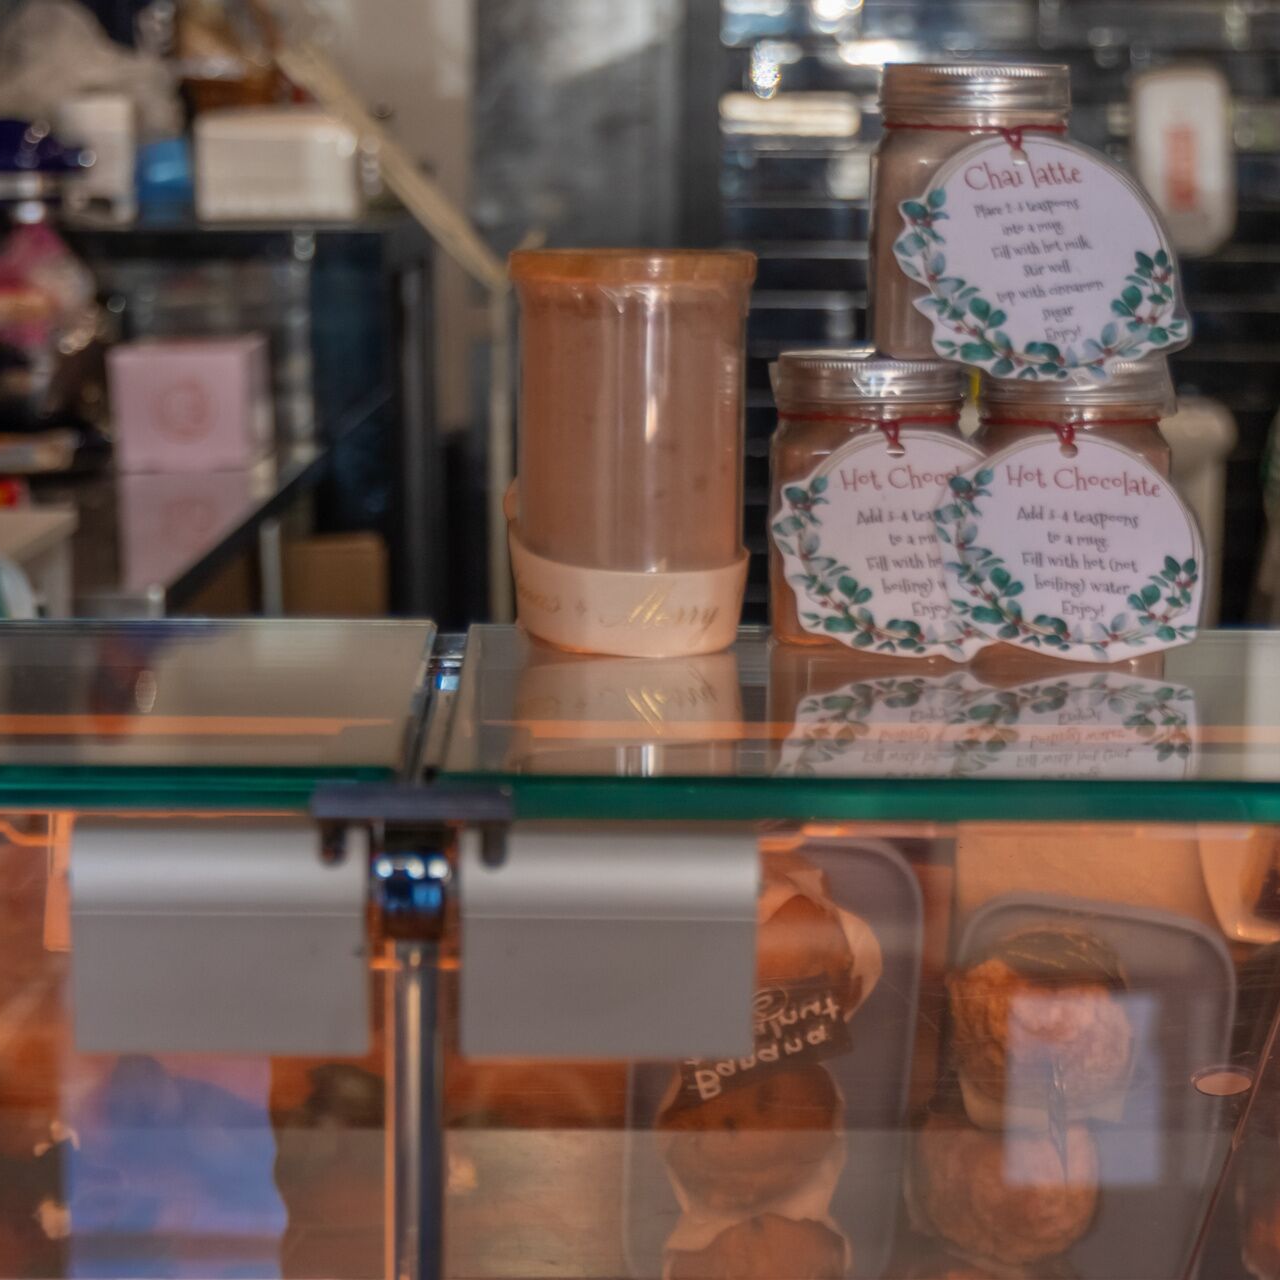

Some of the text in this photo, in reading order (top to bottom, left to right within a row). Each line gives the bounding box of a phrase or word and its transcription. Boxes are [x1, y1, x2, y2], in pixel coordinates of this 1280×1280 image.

[964, 161, 1082, 192] Chai latte
[840, 468, 883, 492] Hot
[1005, 465, 1161, 498] Hot Chocolate
[1017, 506, 1043, 521] Add
[1073, 509, 1139, 529] teaspoons
[1021, 552, 1043, 568] Fill
[1048, 553, 1080, 570] with
[1083, 553, 1105, 569] hot
[1090, 579, 1130, 596] water
[1060, 601, 1105, 620] Enjoy!
